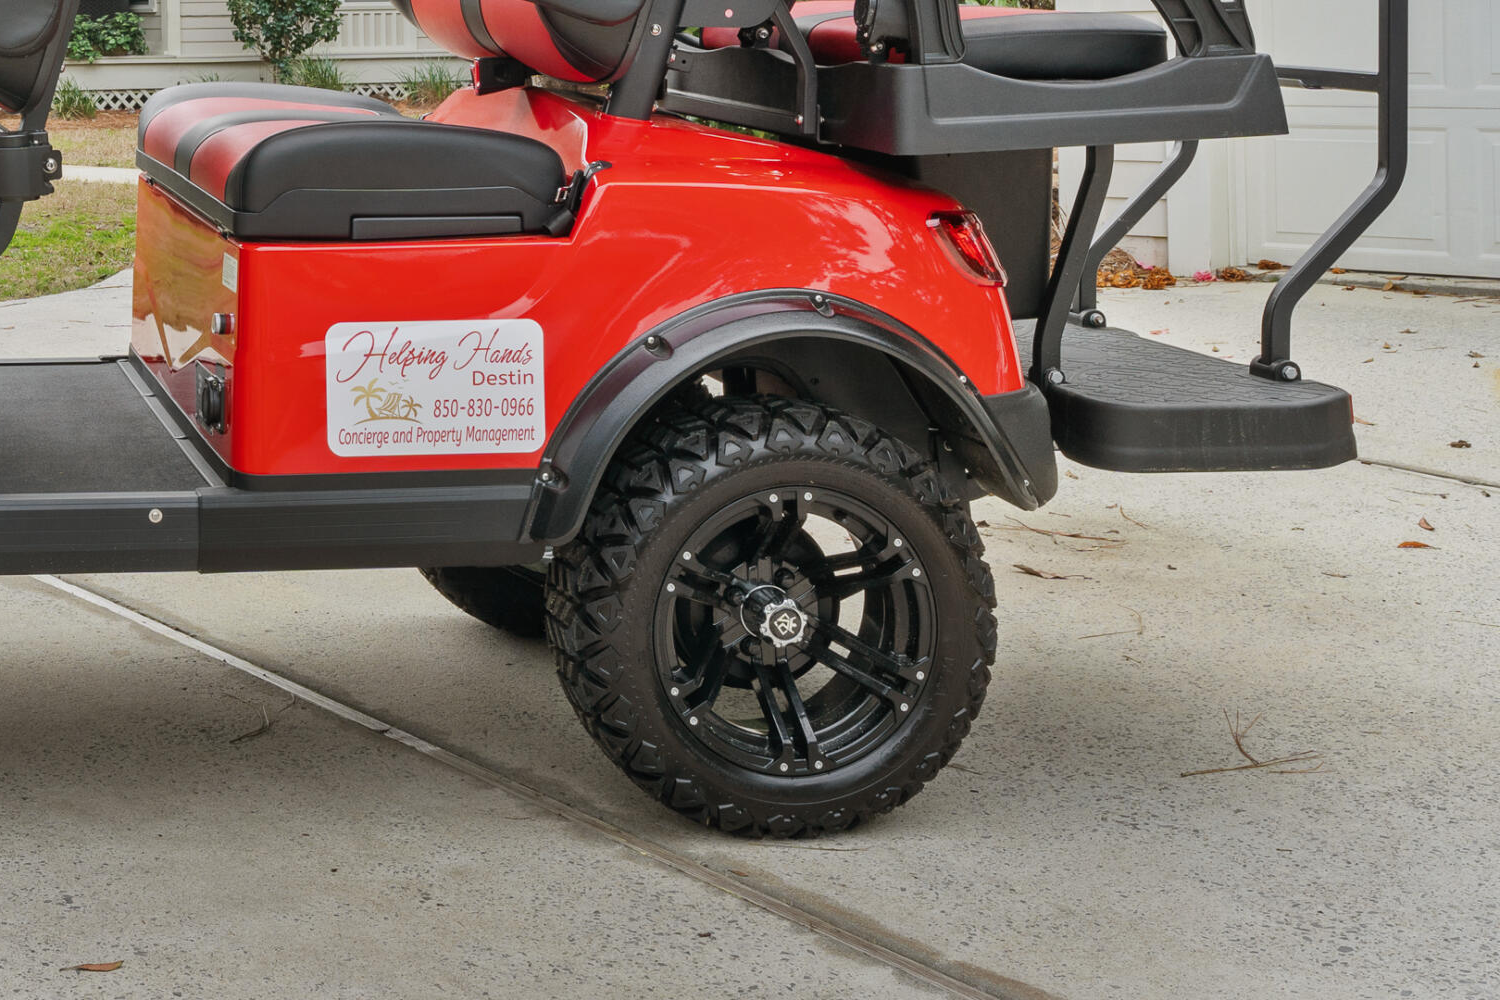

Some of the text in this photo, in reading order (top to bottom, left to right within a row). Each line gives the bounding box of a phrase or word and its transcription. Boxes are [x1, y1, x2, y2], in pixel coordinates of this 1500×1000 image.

[336, 326, 533, 383] Helping Hands
[472, 370, 534, 386] Destin
[433, 398, 534, 418] 850-830-0966
[338, 425, 535, 448] Concierge and Property Management
